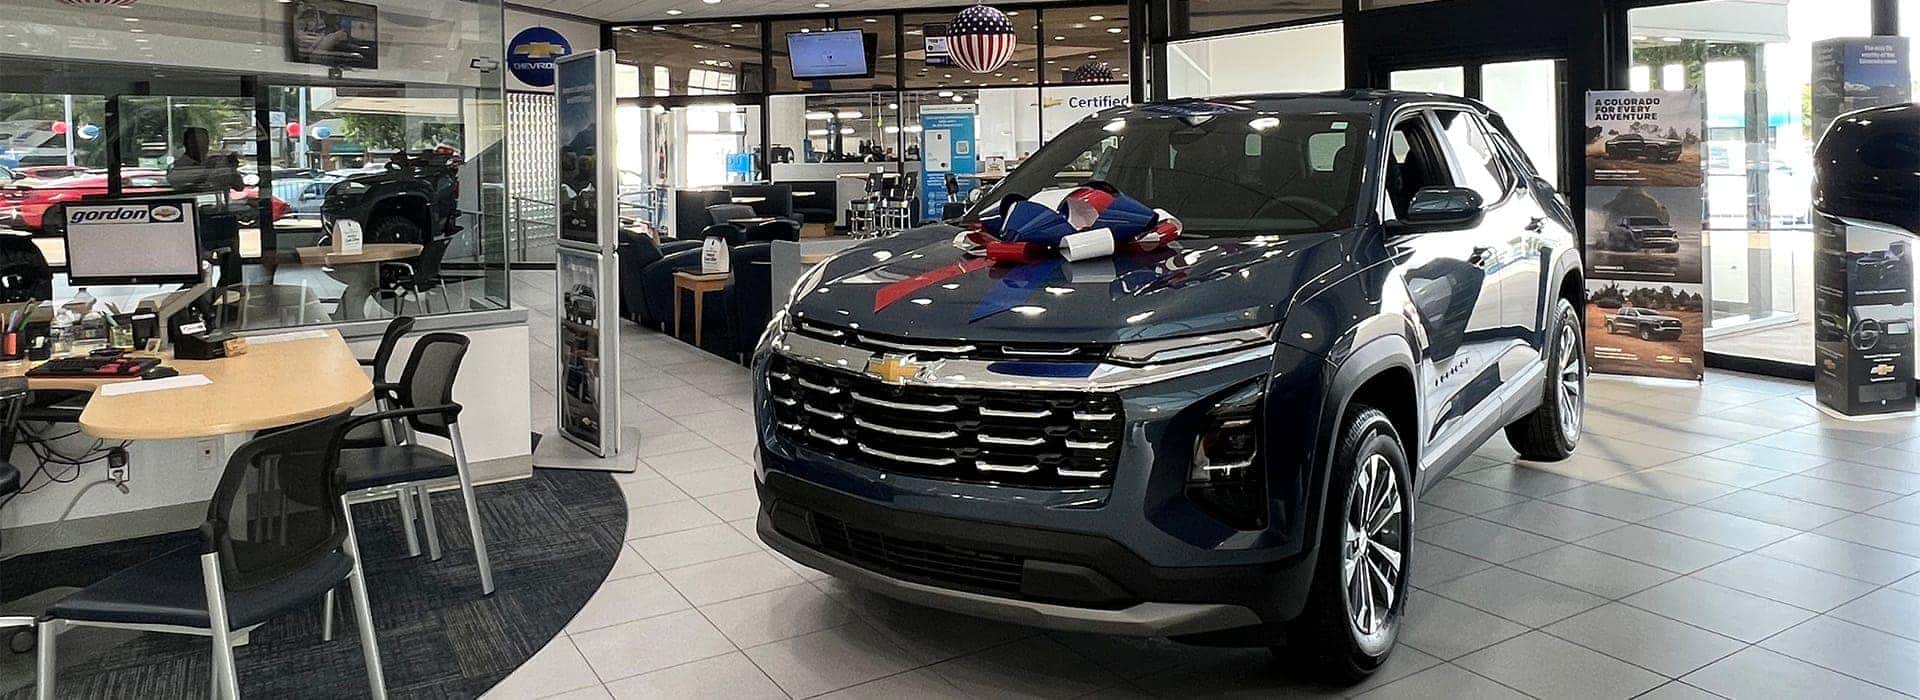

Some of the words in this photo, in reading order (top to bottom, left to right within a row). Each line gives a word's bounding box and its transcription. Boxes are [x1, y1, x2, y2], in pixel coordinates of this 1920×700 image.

[513, 62, 555, 70] CHEVRO
[1069, 95, 1129, 108] Certified
[1604, 98, 1660, 106] COLORADO
[1595, 113, 1658, 121] ADVENTURE
[70, 207, 147, 223] gordon
